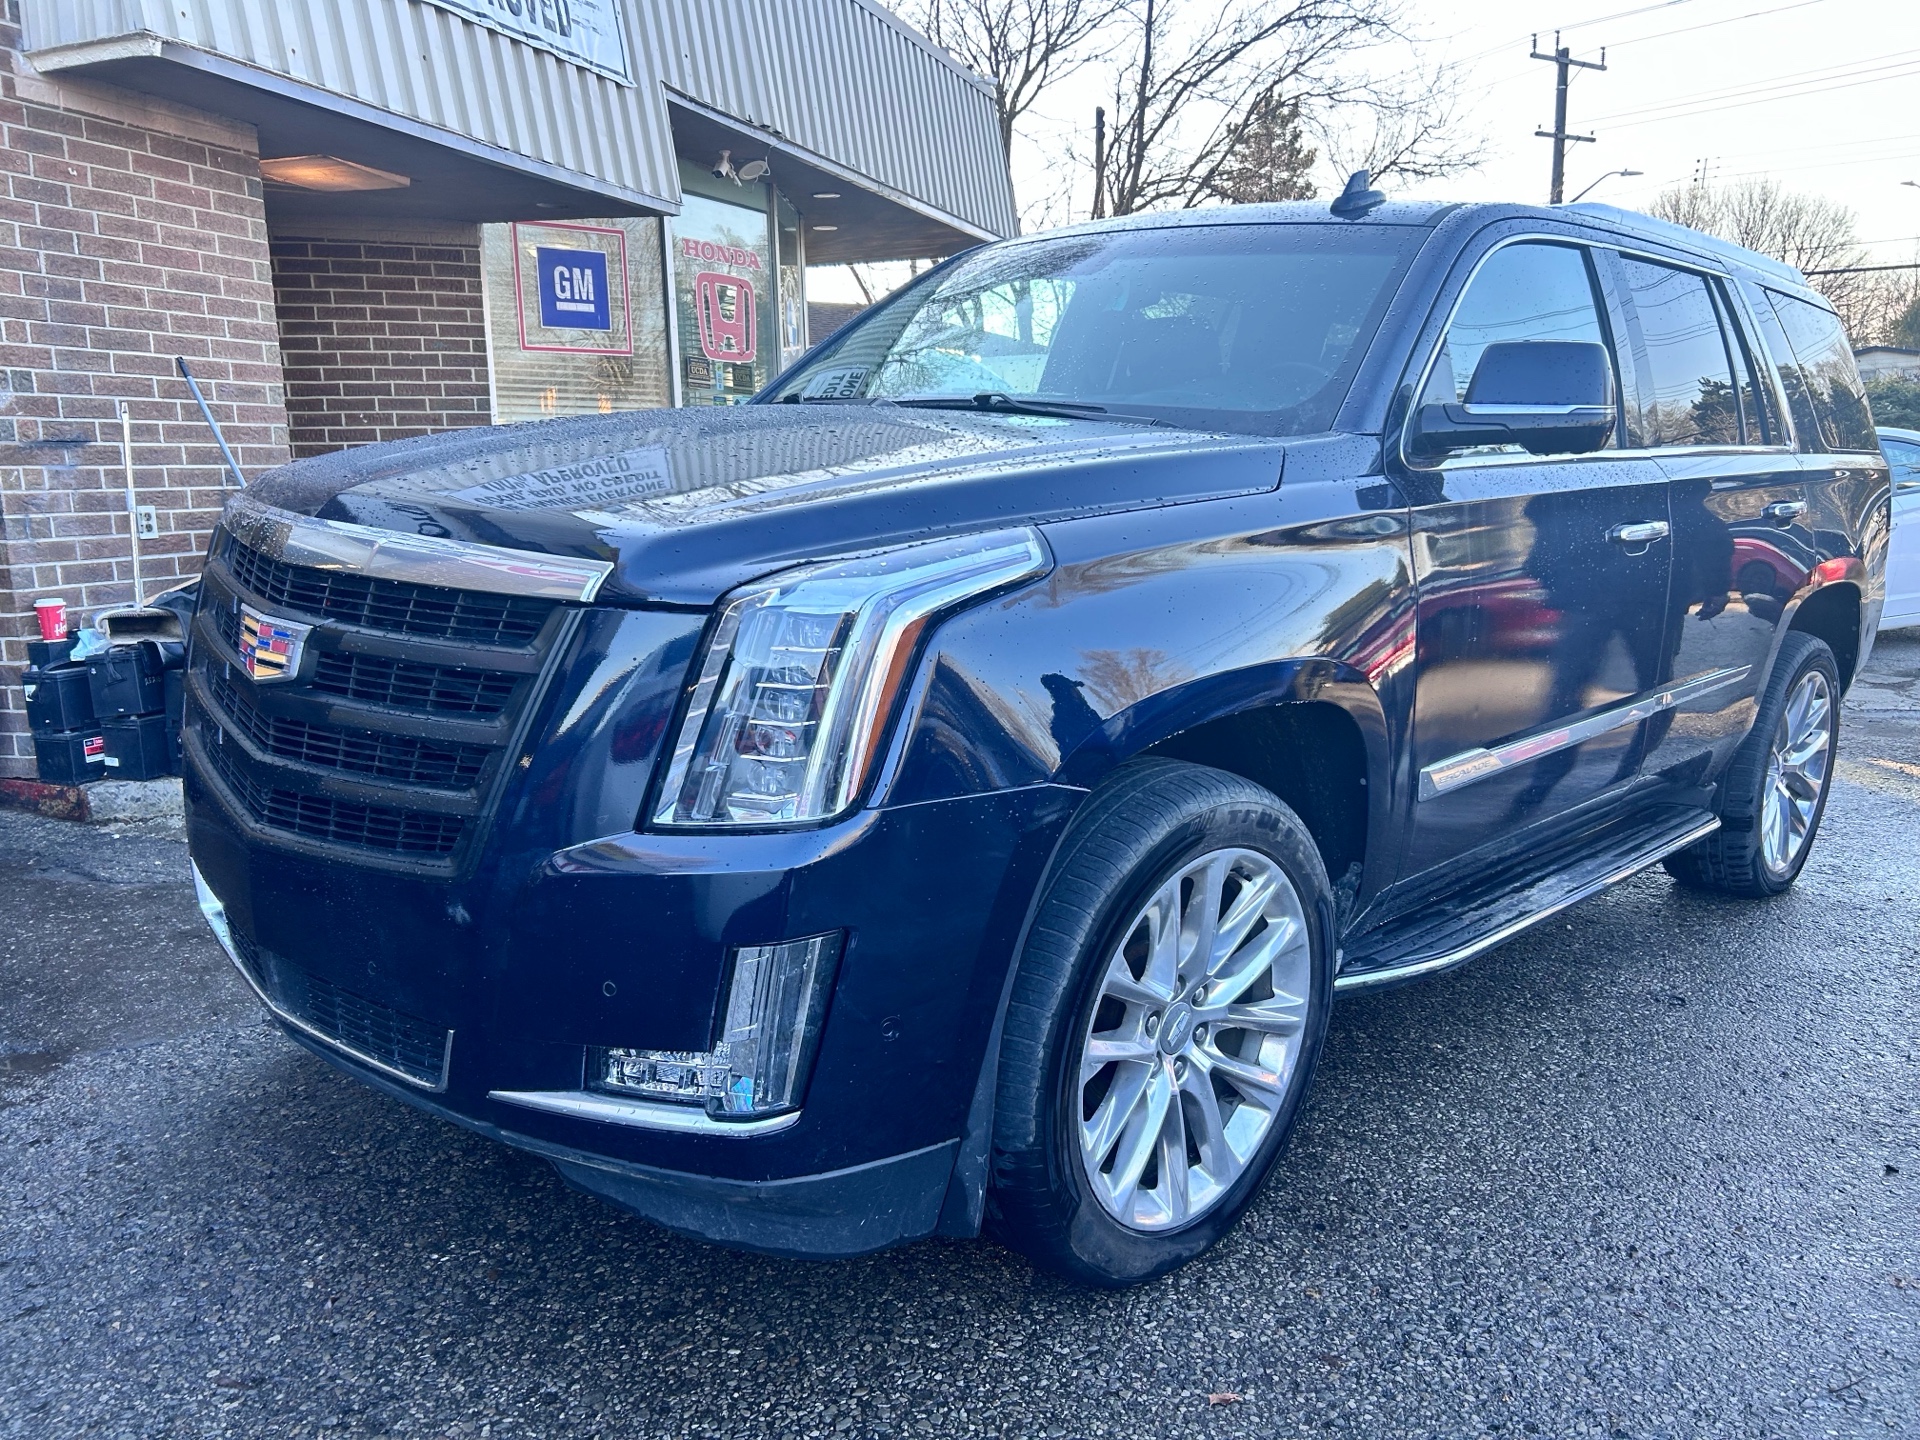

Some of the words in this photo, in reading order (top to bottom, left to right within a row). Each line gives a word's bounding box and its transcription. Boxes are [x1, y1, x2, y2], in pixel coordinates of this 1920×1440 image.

[682, 238, 761, 270] HONDA
[553, 265, 595, 301] GM
[690, 366, 708, 376] UCDA
